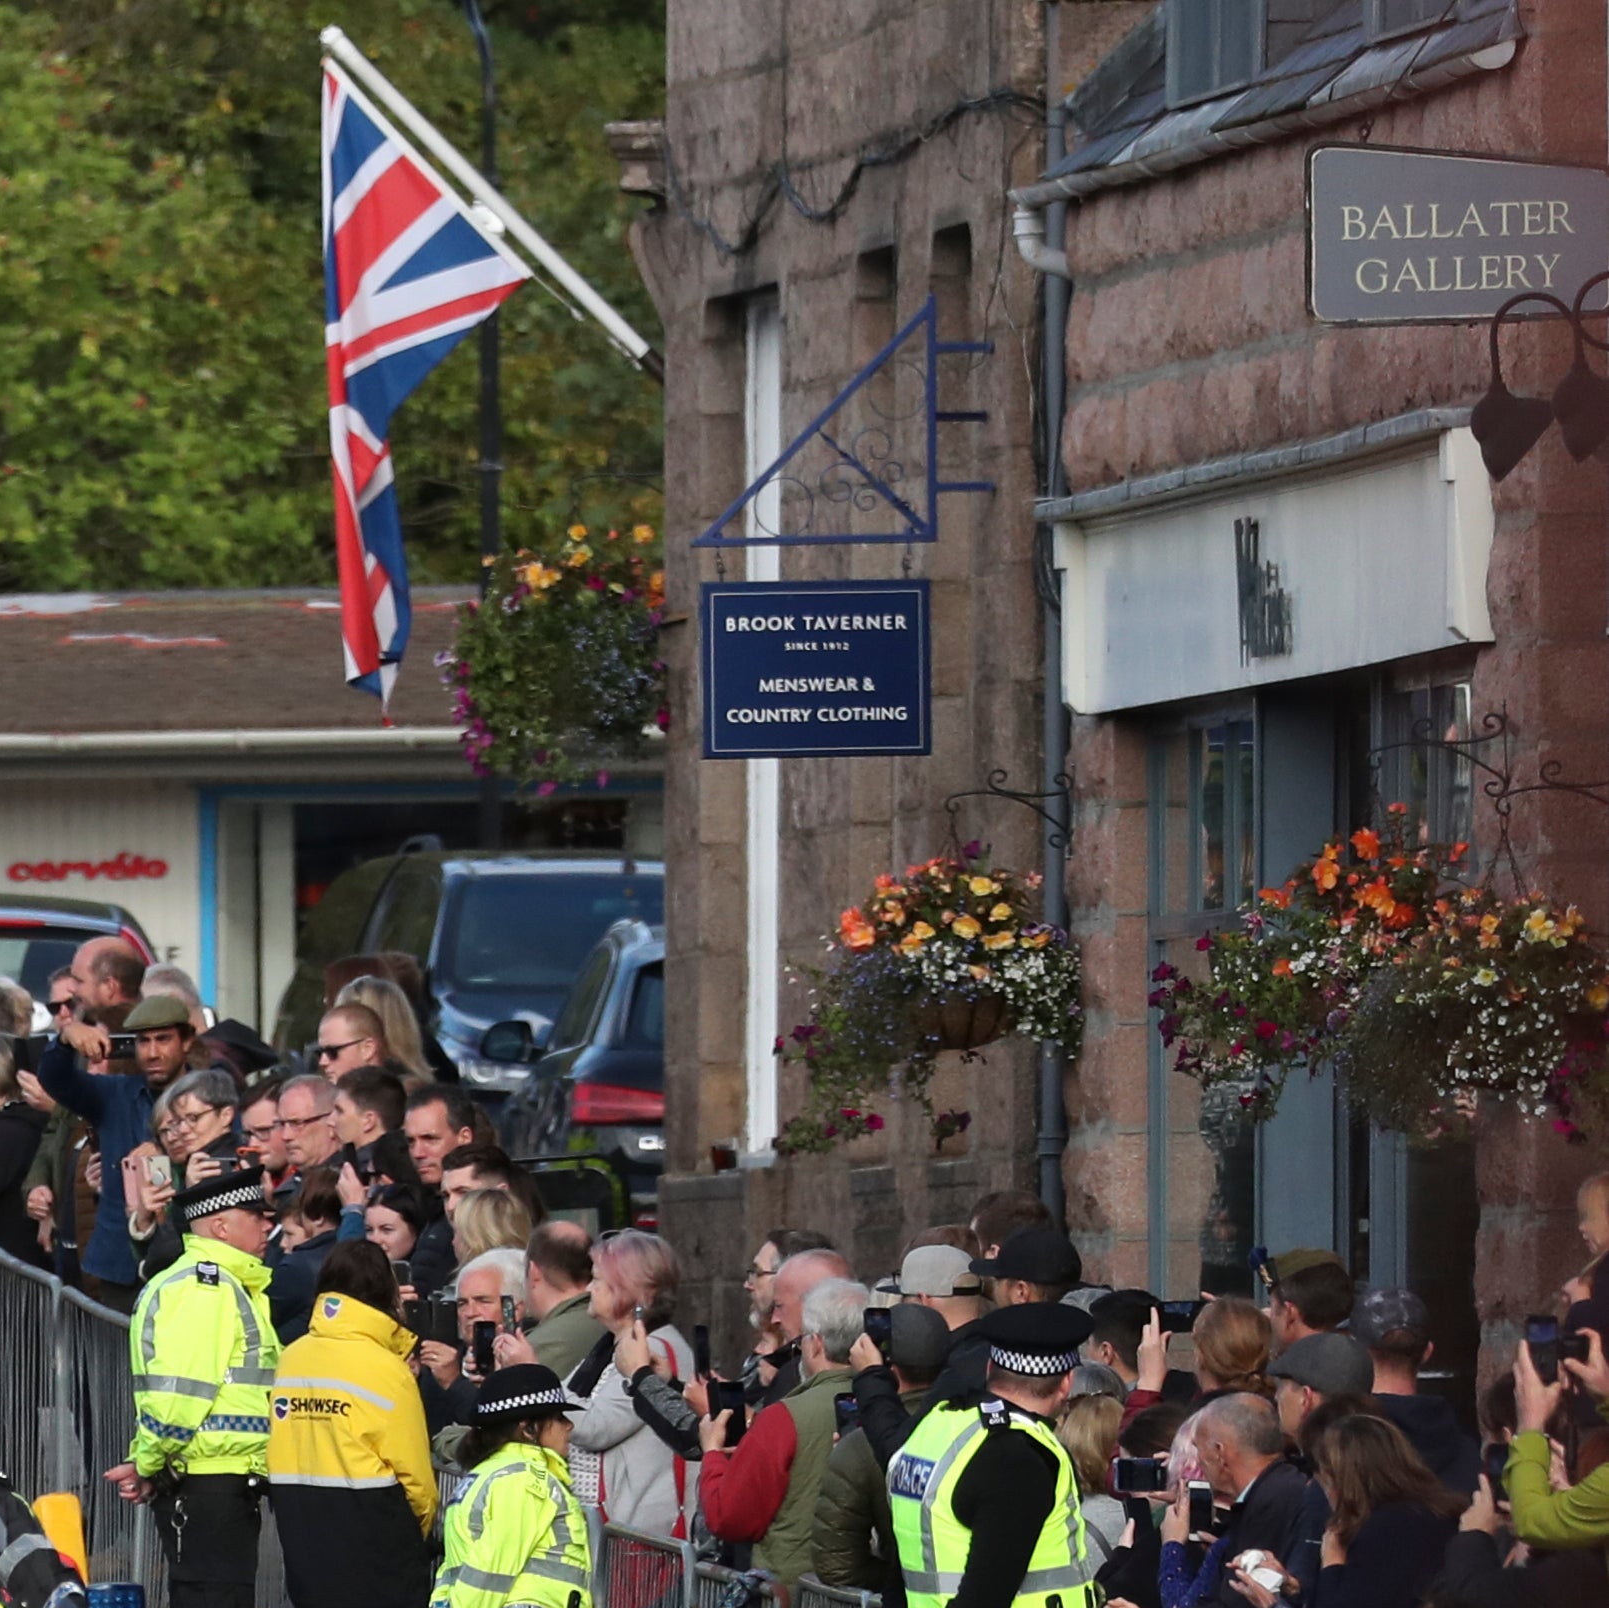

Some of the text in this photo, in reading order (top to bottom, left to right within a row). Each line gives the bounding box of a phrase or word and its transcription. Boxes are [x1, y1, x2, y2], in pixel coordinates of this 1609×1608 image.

[1341, 200, 1576, 241] BALLATER
[1355, 253, 1562, 295] GALLERY
[725, 614, 908, 632] BROOK TAVERNER
[784, 642, 818, 651] SINCE
[758, 676, 875, 693] MENSWEAR &
[726, 706, 908, 724] COUNTRY CLOTHING
[290, 1397, 352, 1417] SHOWSEC
